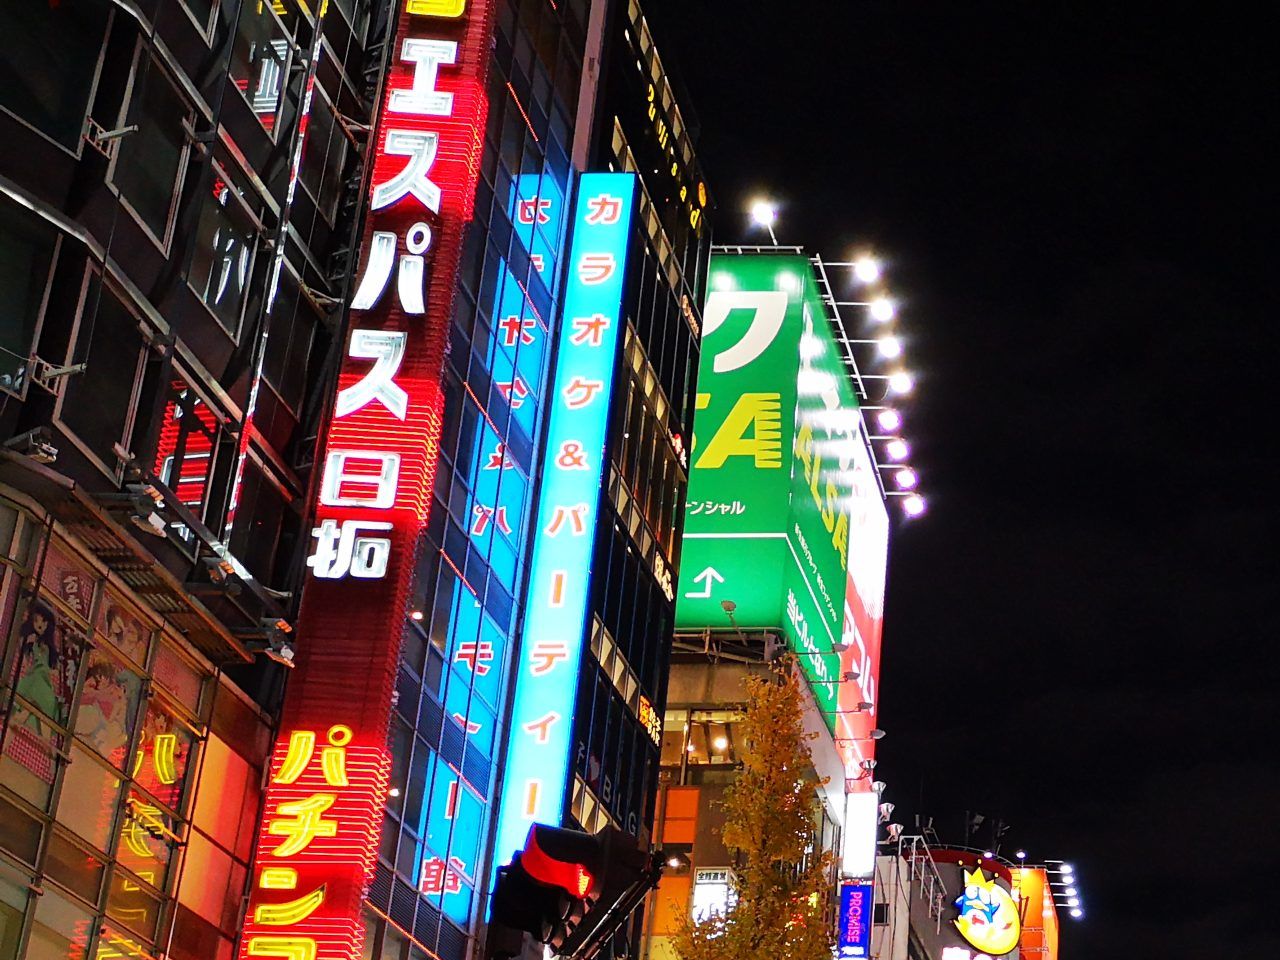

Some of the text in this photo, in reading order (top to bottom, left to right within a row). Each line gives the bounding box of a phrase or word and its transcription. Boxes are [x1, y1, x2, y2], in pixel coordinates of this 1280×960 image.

[308, 37, 459, 579] エスパス日拓
[846, 891, 863, 943] PROMISE
